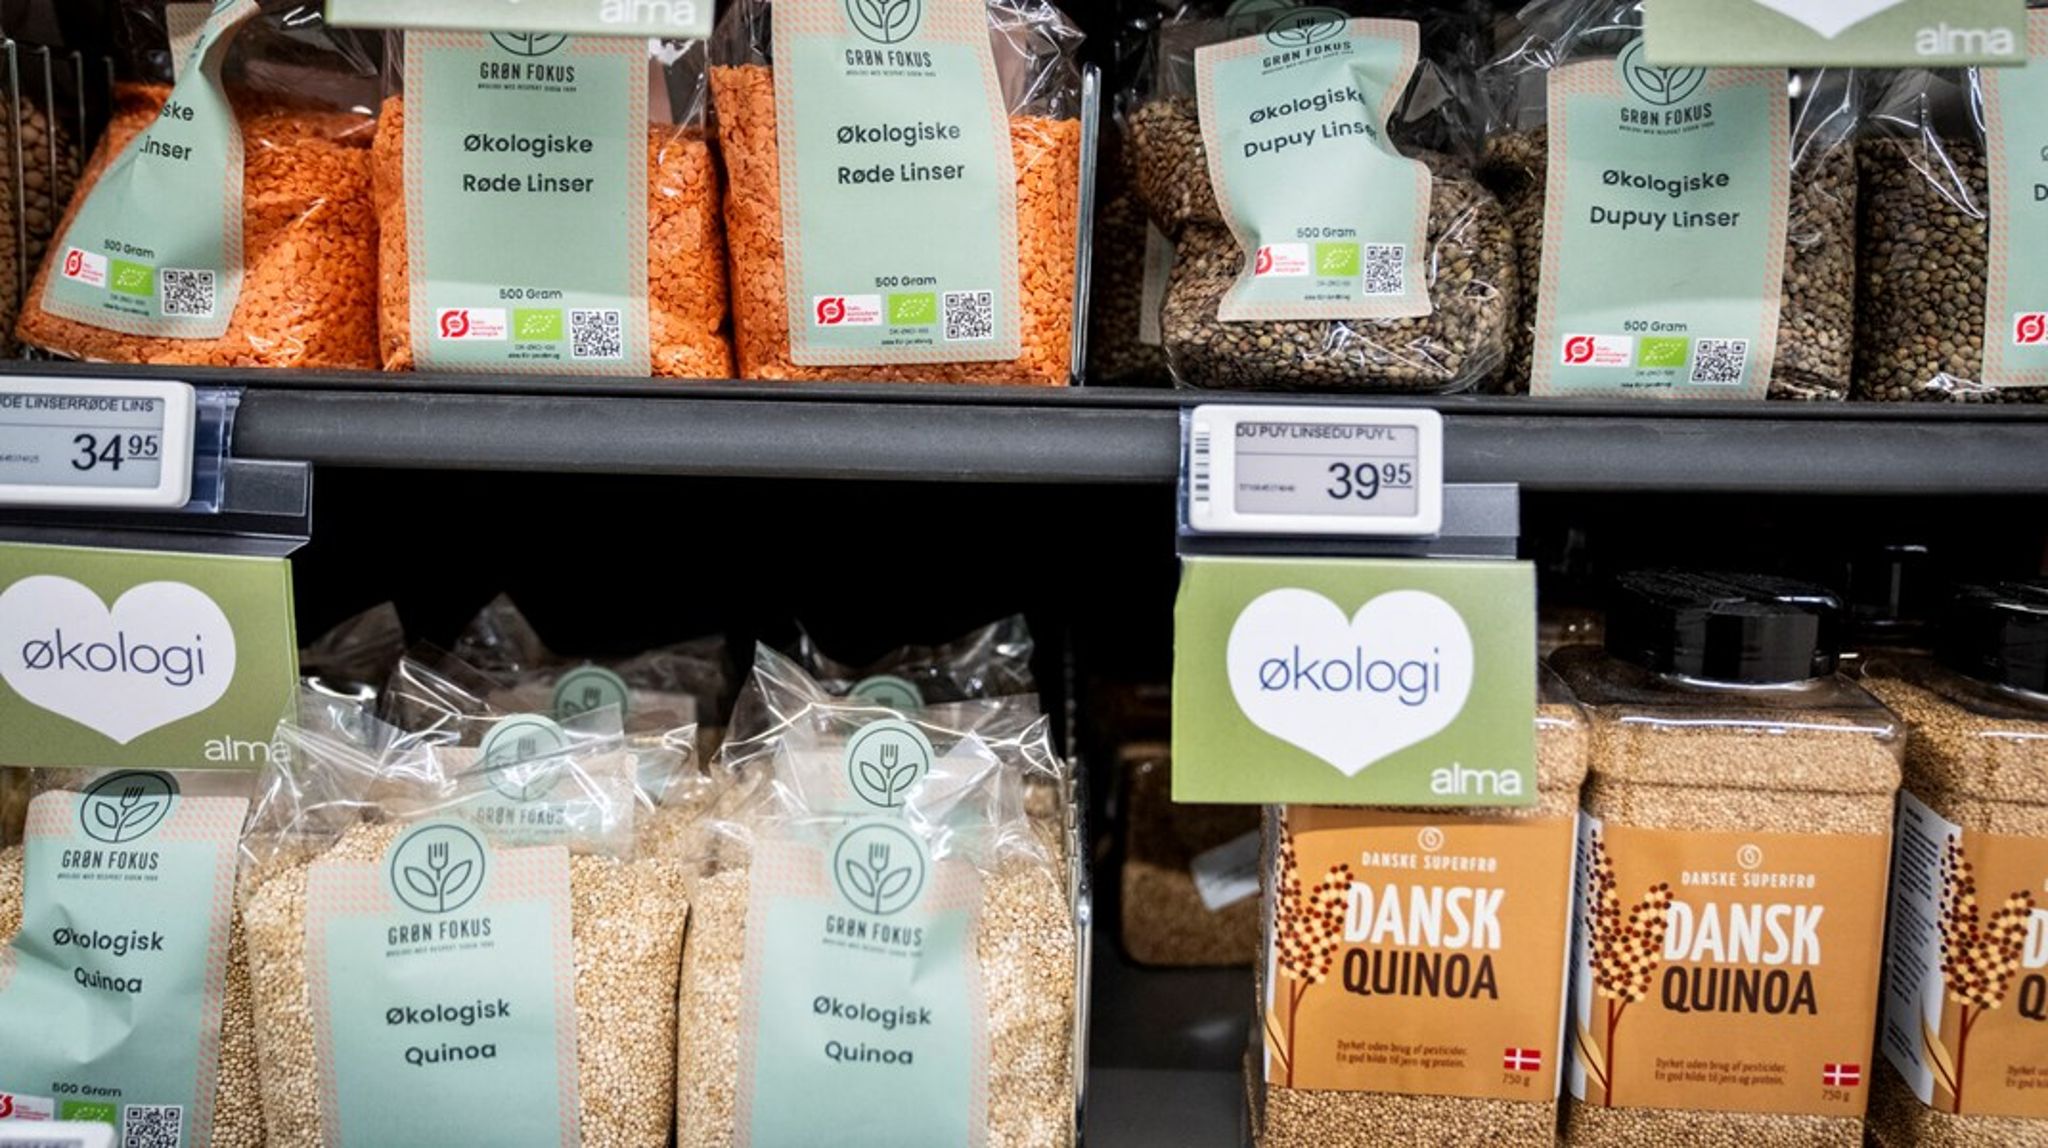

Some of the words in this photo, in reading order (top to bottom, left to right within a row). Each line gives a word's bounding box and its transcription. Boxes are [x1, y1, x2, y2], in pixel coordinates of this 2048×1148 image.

[600, 0, 696, 26] alma
[1916, 22, 2015, 55] alma
[846, 49, 883, 66] GRØN
[888, 50, 932, 68] FOKUS
[480, 62, 521, 80] GRØN
[527, 63, 575, 83] FOKUS
[161, 101, 194, 121] ske
[1620, 107, 1659, 126] GRØN
[1665, 102, 1712, 126] FOKUS
[463, 134, 593, 158] Økologiske
[836, 122, 961, 147] Økologiske
[1243, 129, 1316, 158] Dupuy
[139, 135, 192, 161] inser
[463, 174, 521, 192] Røde
[527, 174, 594, 192] Linser
[838, 164, 895, 184] Røde
[901, 162, 965, 182] Linser
[1602, 169, 1730, 198] Økologiske
[2034, 183, 2048, 201] D
[1590, 206, 1667, 231] Dupuy
[1673, 211, 1740, 228] Linser
[1322, 228, 1357, 238] Gram
[499, 288, 523, 299] 500
[526, 288, 563, 299] Gram
[875, 276, 898, 287] 500
[901, 276, 937, 287] Gram
[1624, 320, 1648, 332] 500
[1651, 320, 1687, 332] Gram
[0, 396, 21, 408] DE
[122, 399, 154, 412] LINS
[1236, 425, 1256, 437] DU
[1259, 425, 1287, 438] PUY
[1291, 427, 1351, 439] LINSEDU
[1356, 428, 1383, 440] PUY
[22, 628, 204, 687] økologi
[1258, 645, 1440, 707] økologi
[204, 735, 292, 763] alma
[1431, 763, 1523, 796] alma
[62, 850, 102, 869] GRØN
[108, 851, 160, 871] FOKUS
[1362, 851, 1416, 868] DANSKE
[1424, 853, 1497, 872] SUPERFRØ
[1681, 871, 1737, 887] DANSKE
[1743, 871, 1815, 888] SUPERFRØ
[1344, 881, 1505, 950] DANSK
[53, 928, 164, 956] Økologisk
[387, 923, 433, 947] GRØN
[439, 917, 492, 940] FOKUS
[826, 914, 867, 938] GRØN
[872, 921, 923, 947] FOKUS
[1663, 900, 1824, 965] DANSK
[2022, 907, 2048, 968] D
[74, 966, 142, 993] Quinoa
[1343, 947, 1499, 1000] QUINOA
[1661, 965, 1818, 1015] QUINOA
[2018, 973, 2047, 1021] Q
[386, 999, 510, 1025] Økologisk
[813, 995, 932, 1029] Økologisk
[404, 1043, 497, 1066] Quinoa
[824, 1040, 913, 1066] Quinoa
[81, 1086, 122, 1097] Gram
